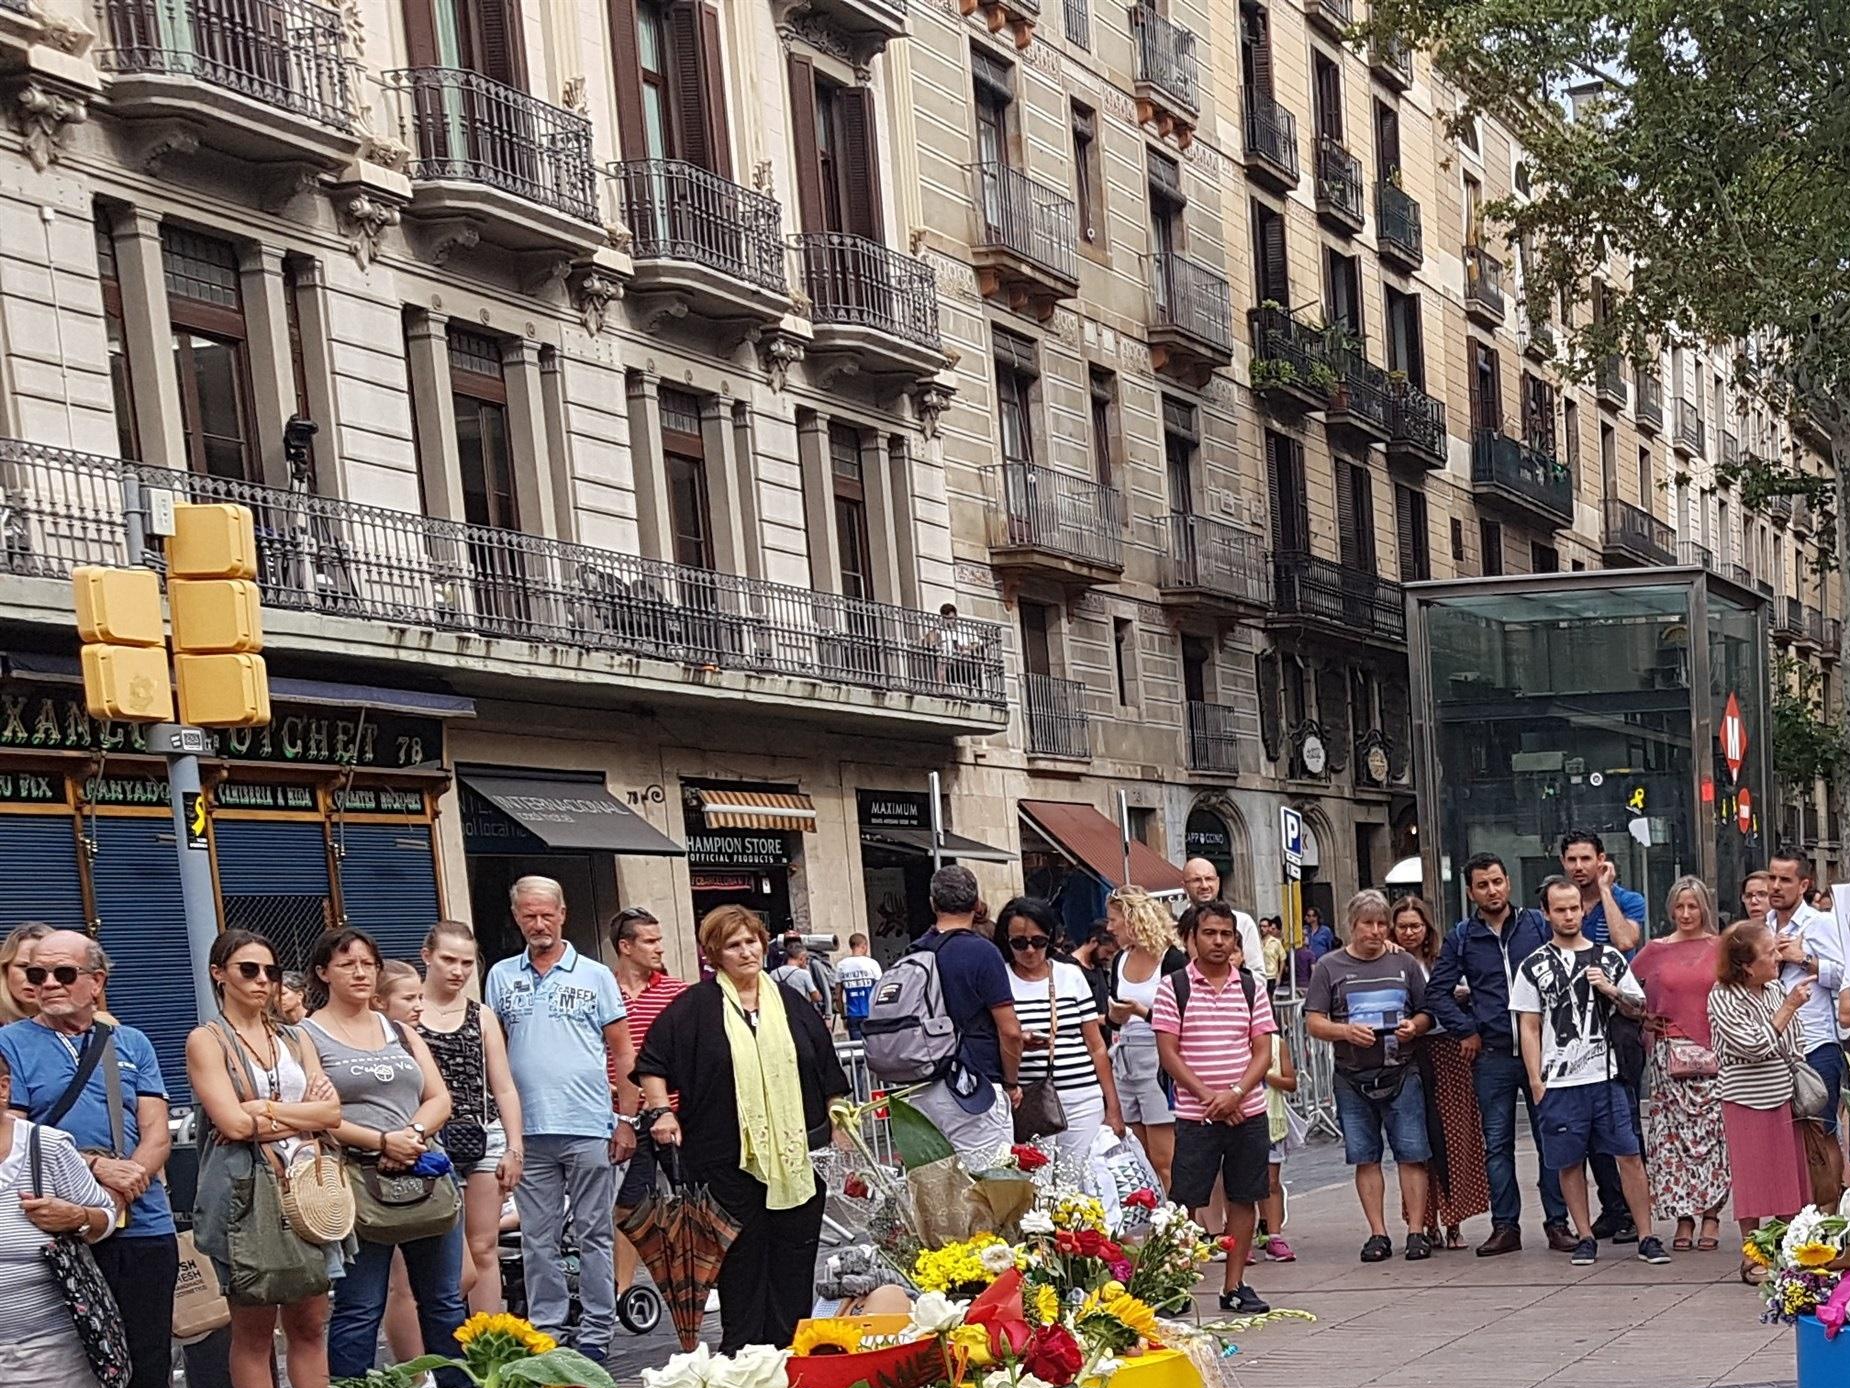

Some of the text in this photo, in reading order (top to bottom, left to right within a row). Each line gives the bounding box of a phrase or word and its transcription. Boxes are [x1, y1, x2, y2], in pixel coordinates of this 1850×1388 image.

[1726, 715, 1740, 760] M
[396, 736, 424, 765] 78
[491, 794, 631, 816] INTERNACIONAL
[871, 801, 918, 816] MAXIMUM
[1286, 813, 1299, 849] P
[686, 836, 783, 855] HAMPION STORE
[690, 853, 774, 864] OFFICIAL PRODUCTS
